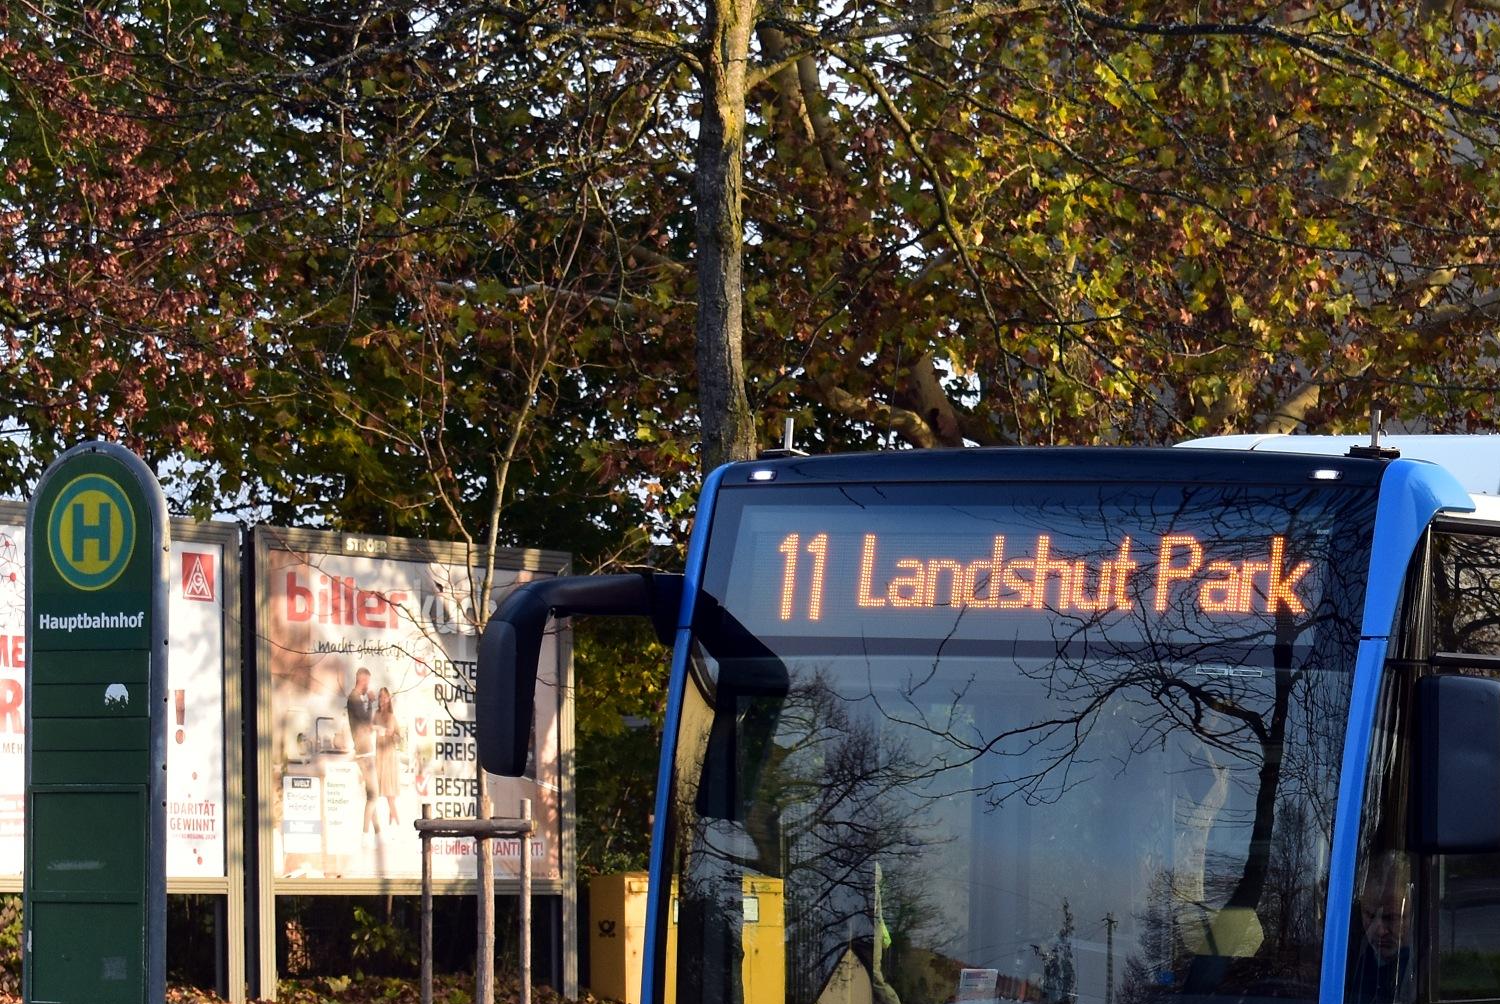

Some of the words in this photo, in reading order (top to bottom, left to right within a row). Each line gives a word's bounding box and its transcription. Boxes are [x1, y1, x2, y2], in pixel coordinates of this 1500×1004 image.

[72, 503, 111, 562] H
[346, 538, 387, 553] STRÖER
[778, 533, 828, 620] 11
[858, 534, 1137, 611] Landshut
[1155, 536, 1311, 614] Park
[286, 572, 408, 629] biller
[39, 611, 145, 632] Hauptbahnhof
[436, 777, 478, 797] BESTE
[169, 817, 216, 832] GEWINNT
